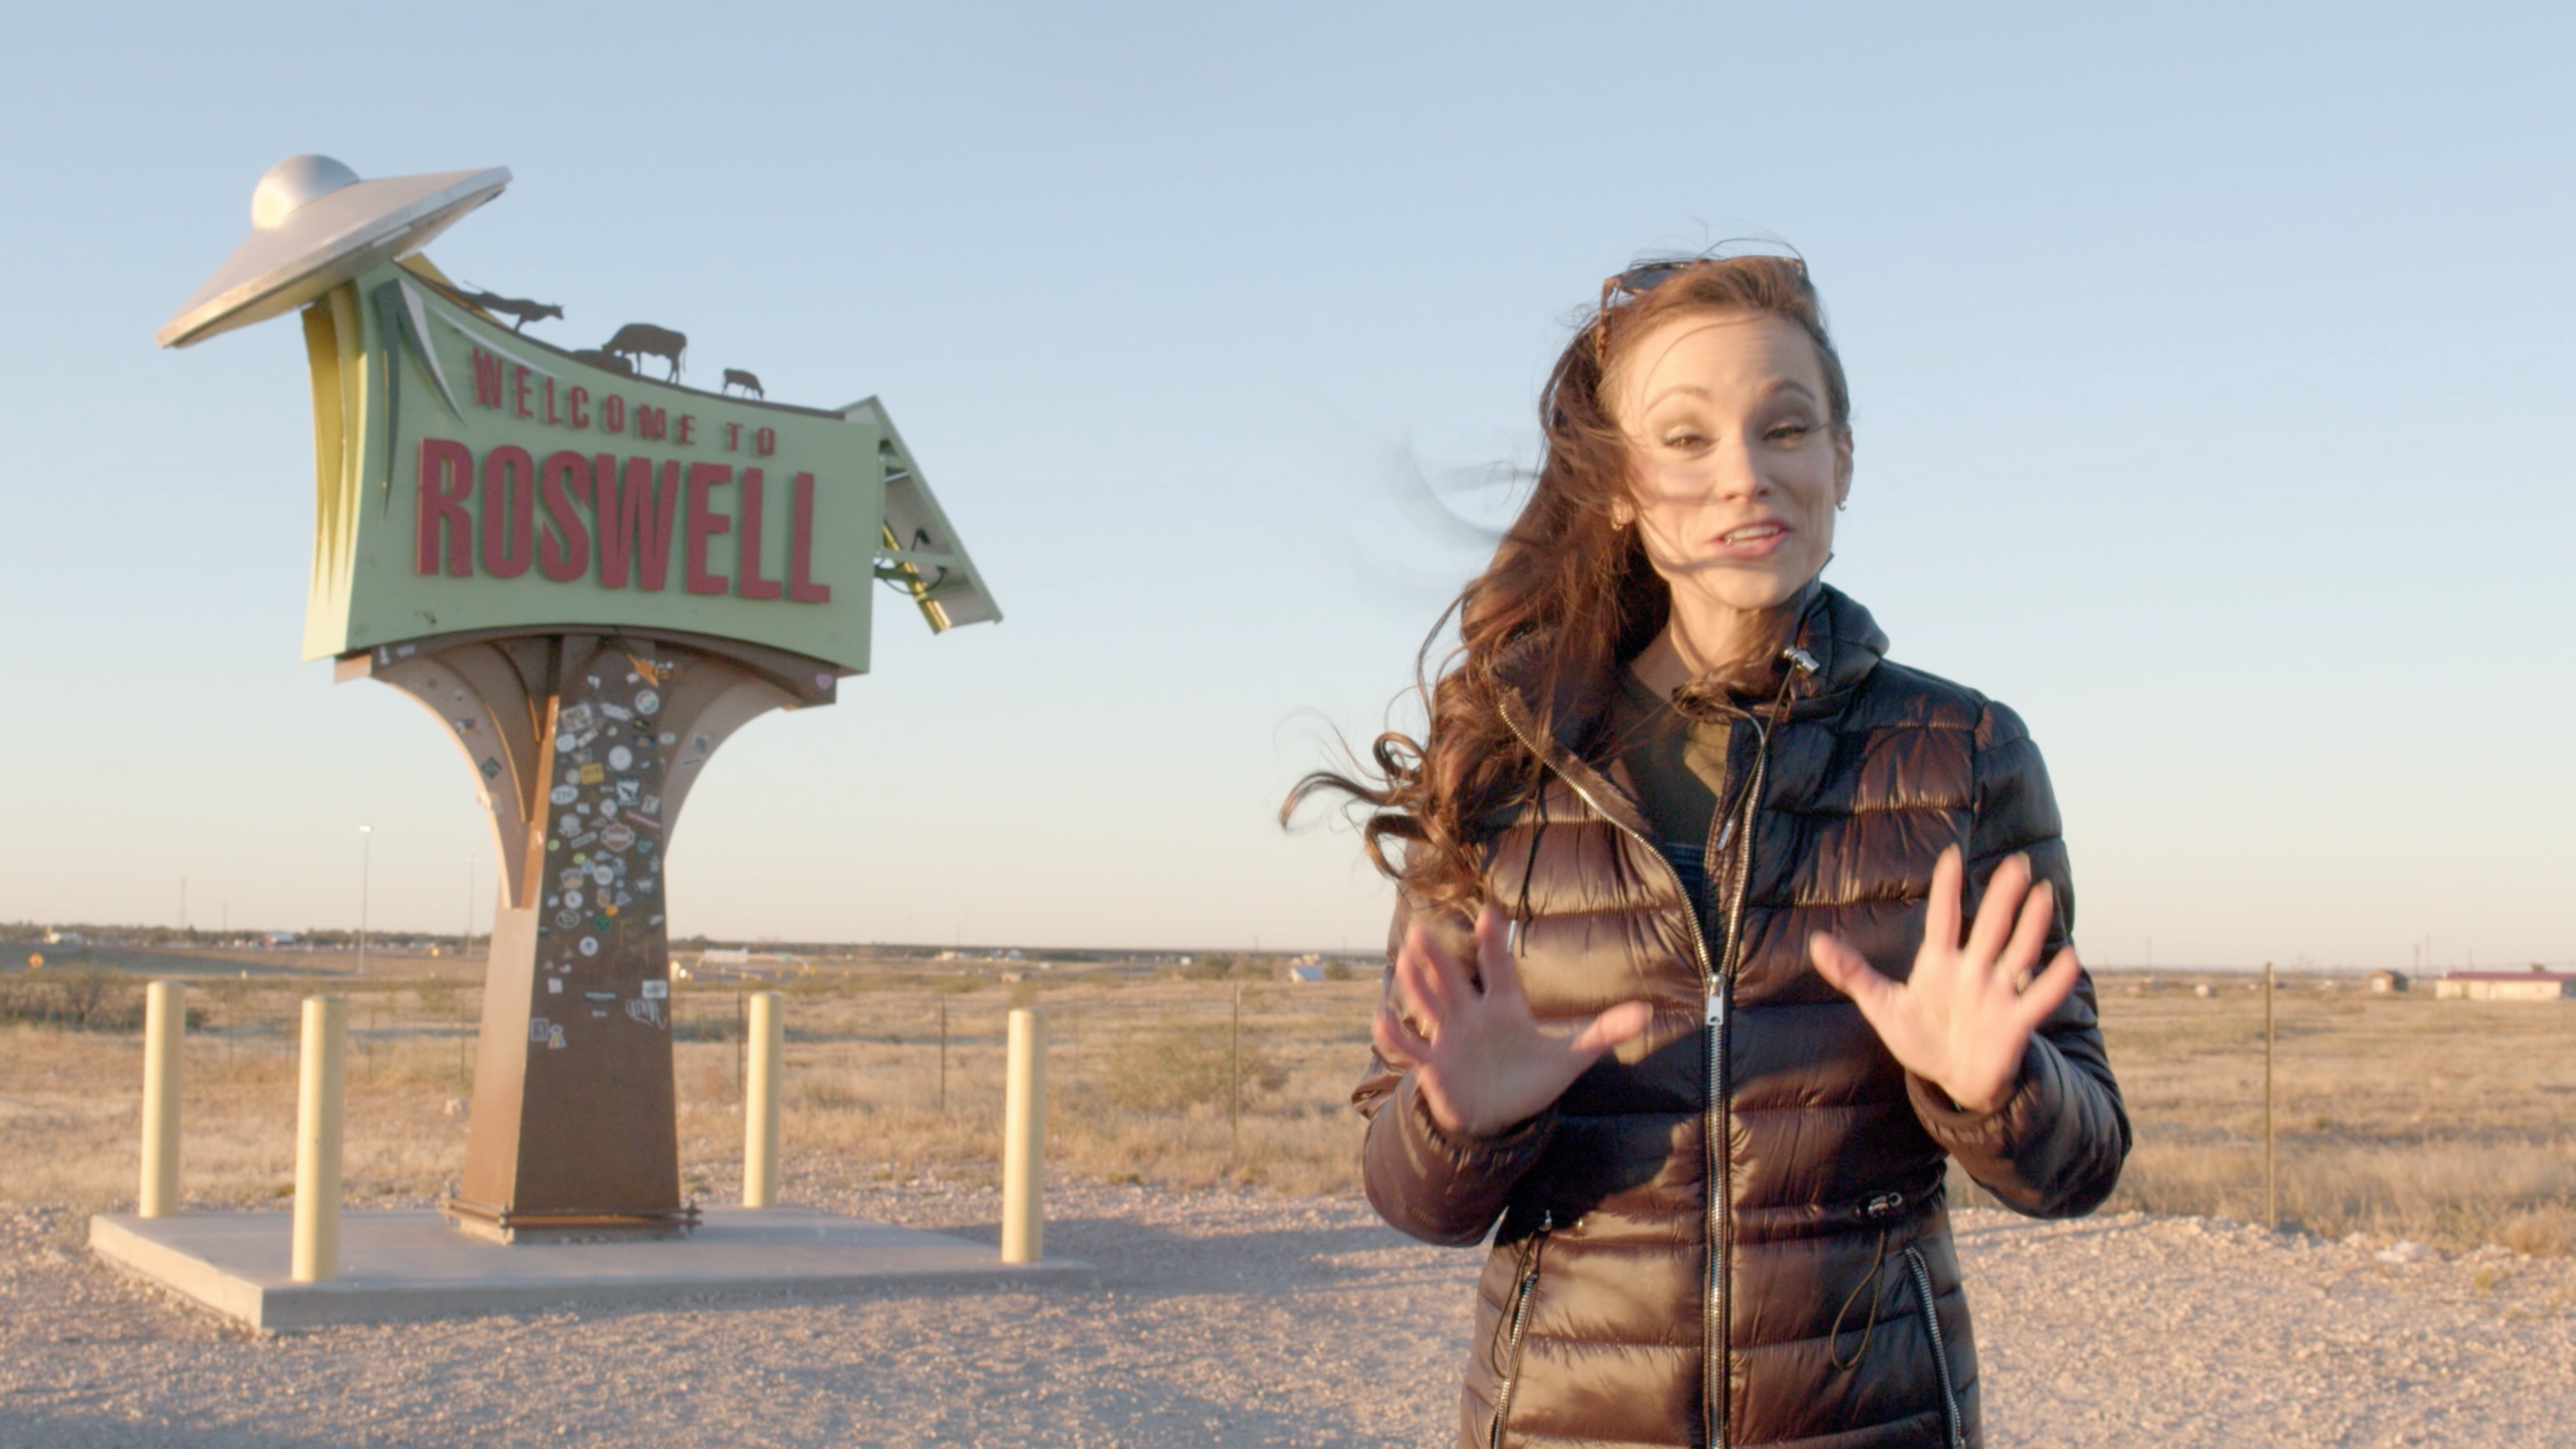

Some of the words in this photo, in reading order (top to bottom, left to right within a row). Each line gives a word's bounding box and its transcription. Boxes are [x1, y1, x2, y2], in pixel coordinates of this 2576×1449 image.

[472, 346, 696, 445] WELCOME
[726, 422, 775, 456] TO
[416, 437, 831, 603] ROSWELL
